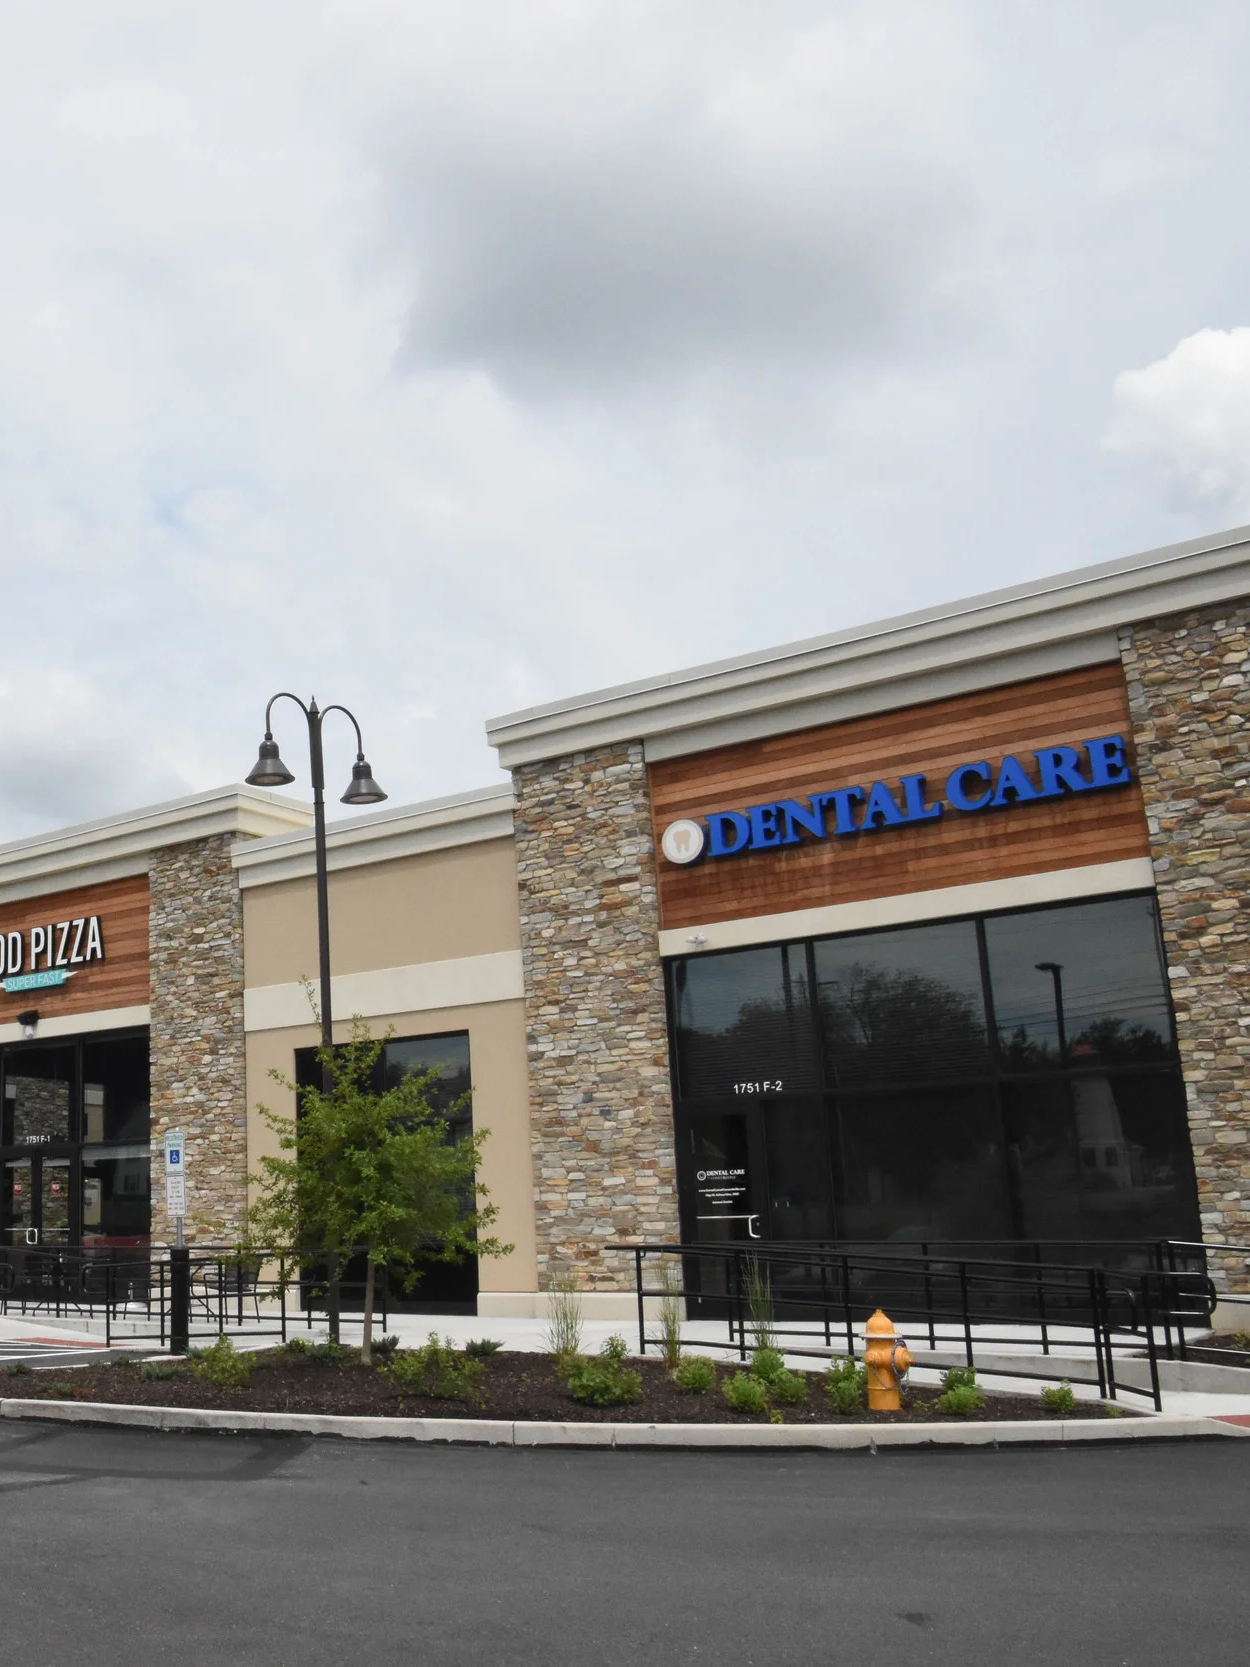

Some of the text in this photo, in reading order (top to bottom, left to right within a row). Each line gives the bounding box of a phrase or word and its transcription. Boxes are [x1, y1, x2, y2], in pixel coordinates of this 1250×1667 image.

[705, 734, 1132, 857] DENTAL CARE
[31, 915, 103, 970] PIZZA
[7, 970, 60, 991] SUPER FAST
[733, 1080, 783, 1094] 1751 F-2
[26, 1134, 51, 1144] 1751 F-1
